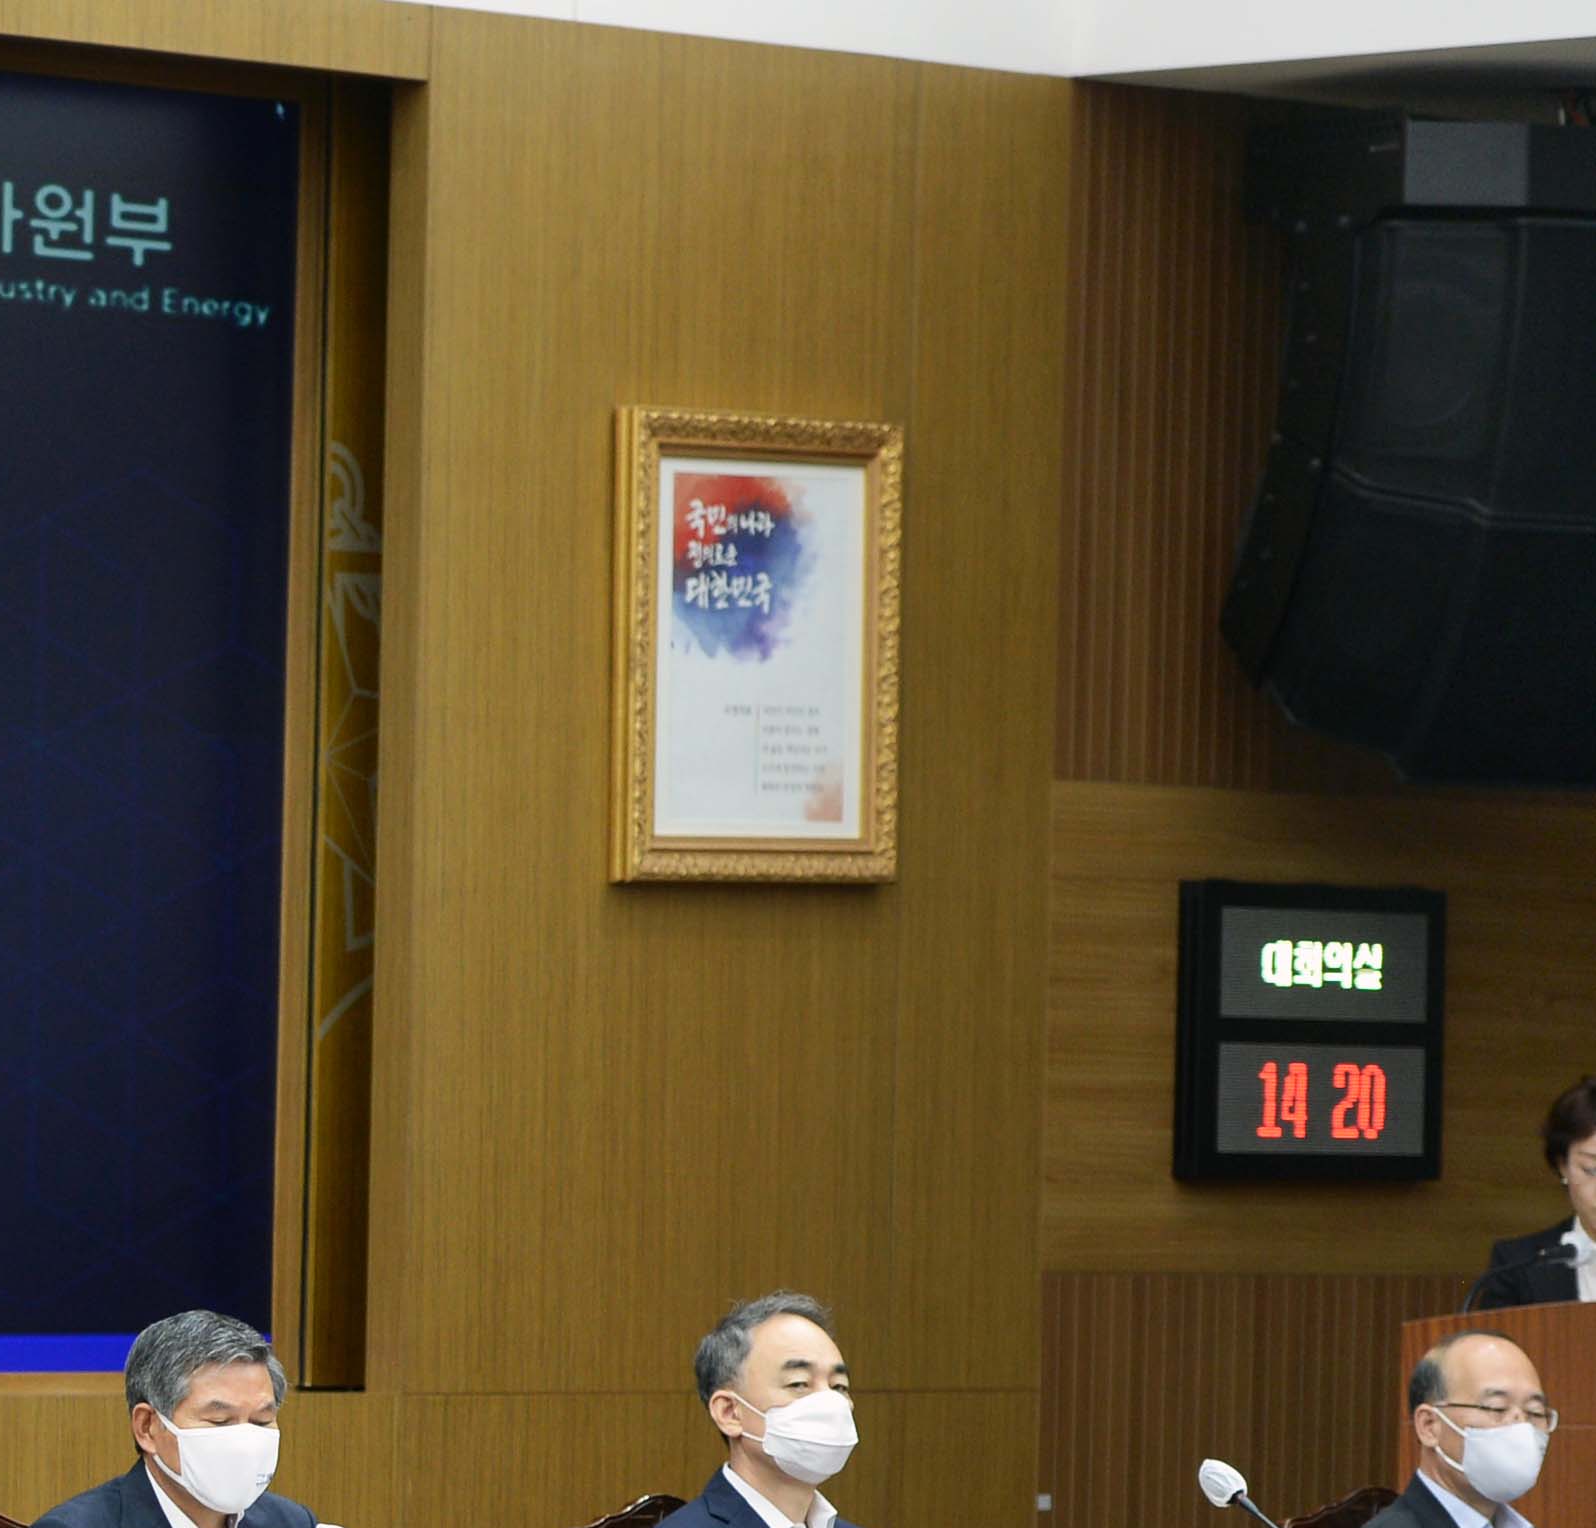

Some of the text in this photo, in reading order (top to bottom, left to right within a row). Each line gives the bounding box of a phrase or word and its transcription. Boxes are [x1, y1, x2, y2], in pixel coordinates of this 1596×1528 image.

[87, 286, 150, 312] and
[160, 288, 271, 327] Energy
[685, 570, 773, 614] 대한민국
[1256, 1061, 1387, 1140] 14 20
